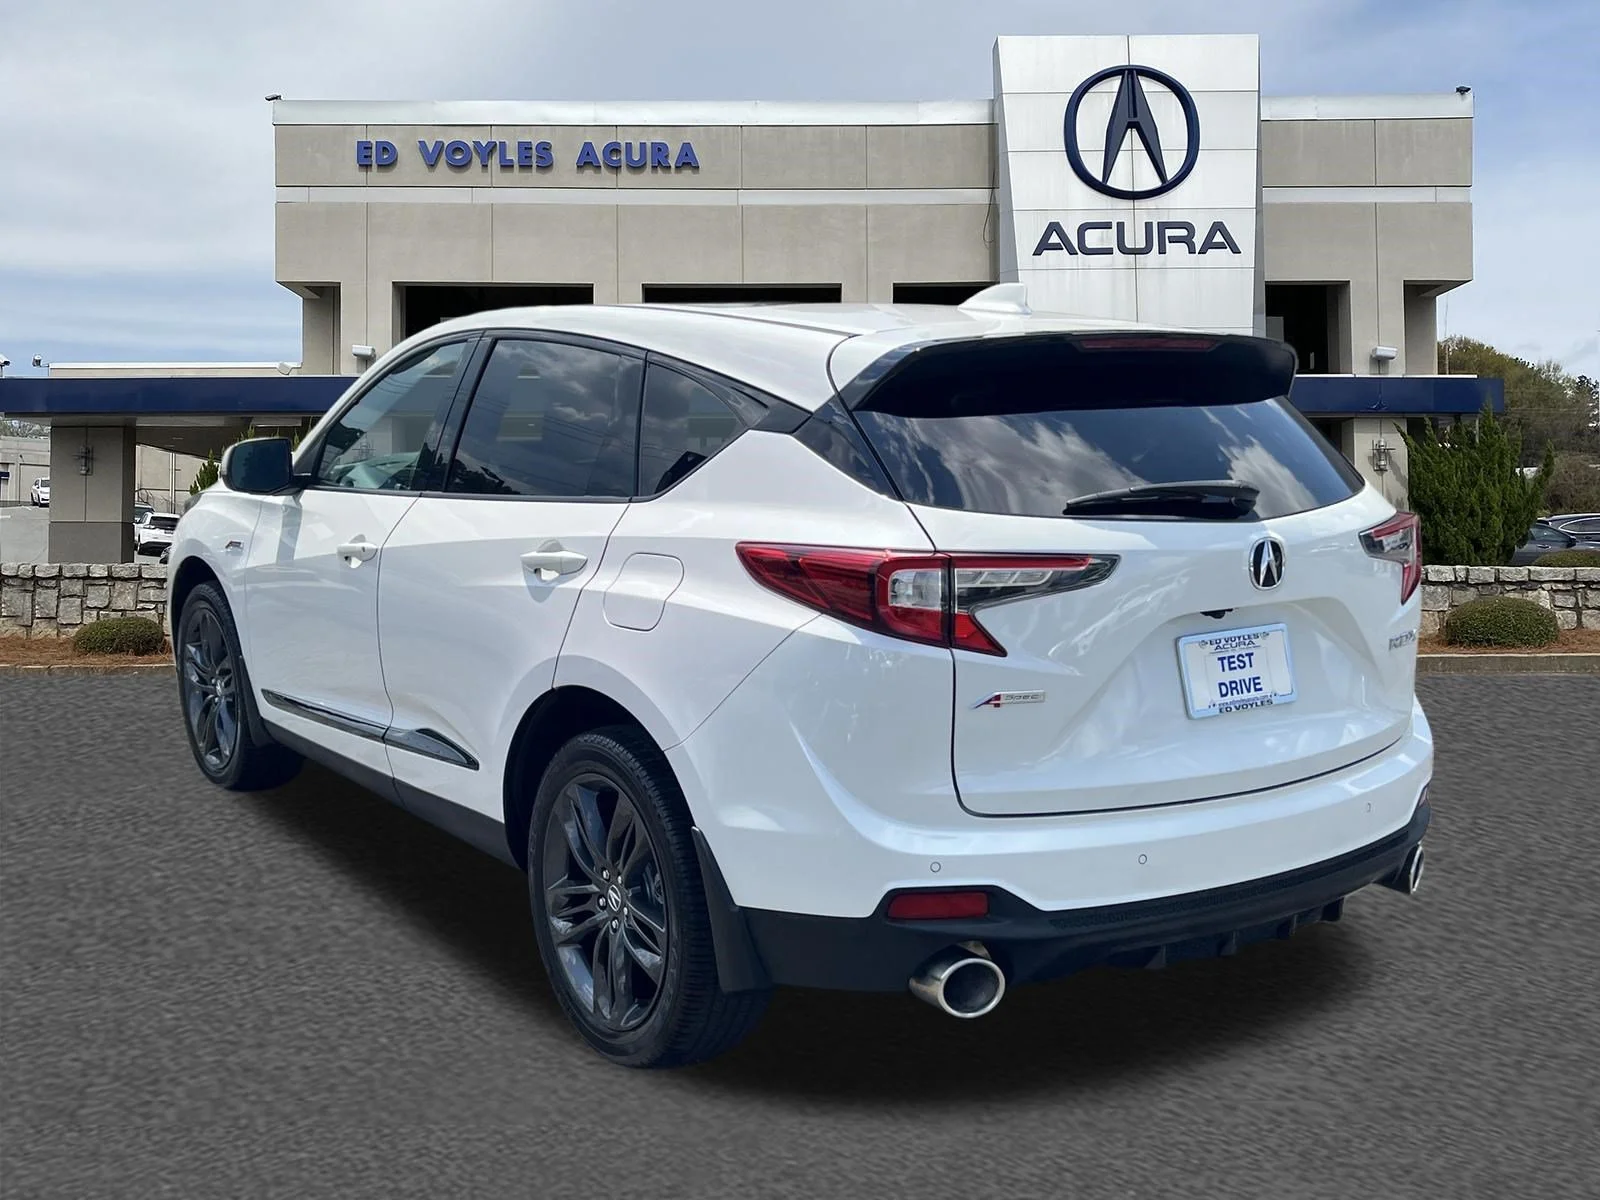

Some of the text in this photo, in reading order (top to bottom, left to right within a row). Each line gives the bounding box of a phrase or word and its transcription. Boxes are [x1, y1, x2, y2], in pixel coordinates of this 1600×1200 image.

[356, 140, 700, 169] ED VOYLES ACURA
[1032, 221, 1242, 256] ACURA
[1214, 640, 1256, 651] ACURA
[1217, 652, 1254, 672] TEST
[1218, 676, 1263, 698] DRIVE
[1234, 699, 1274, 711] VOYLES
